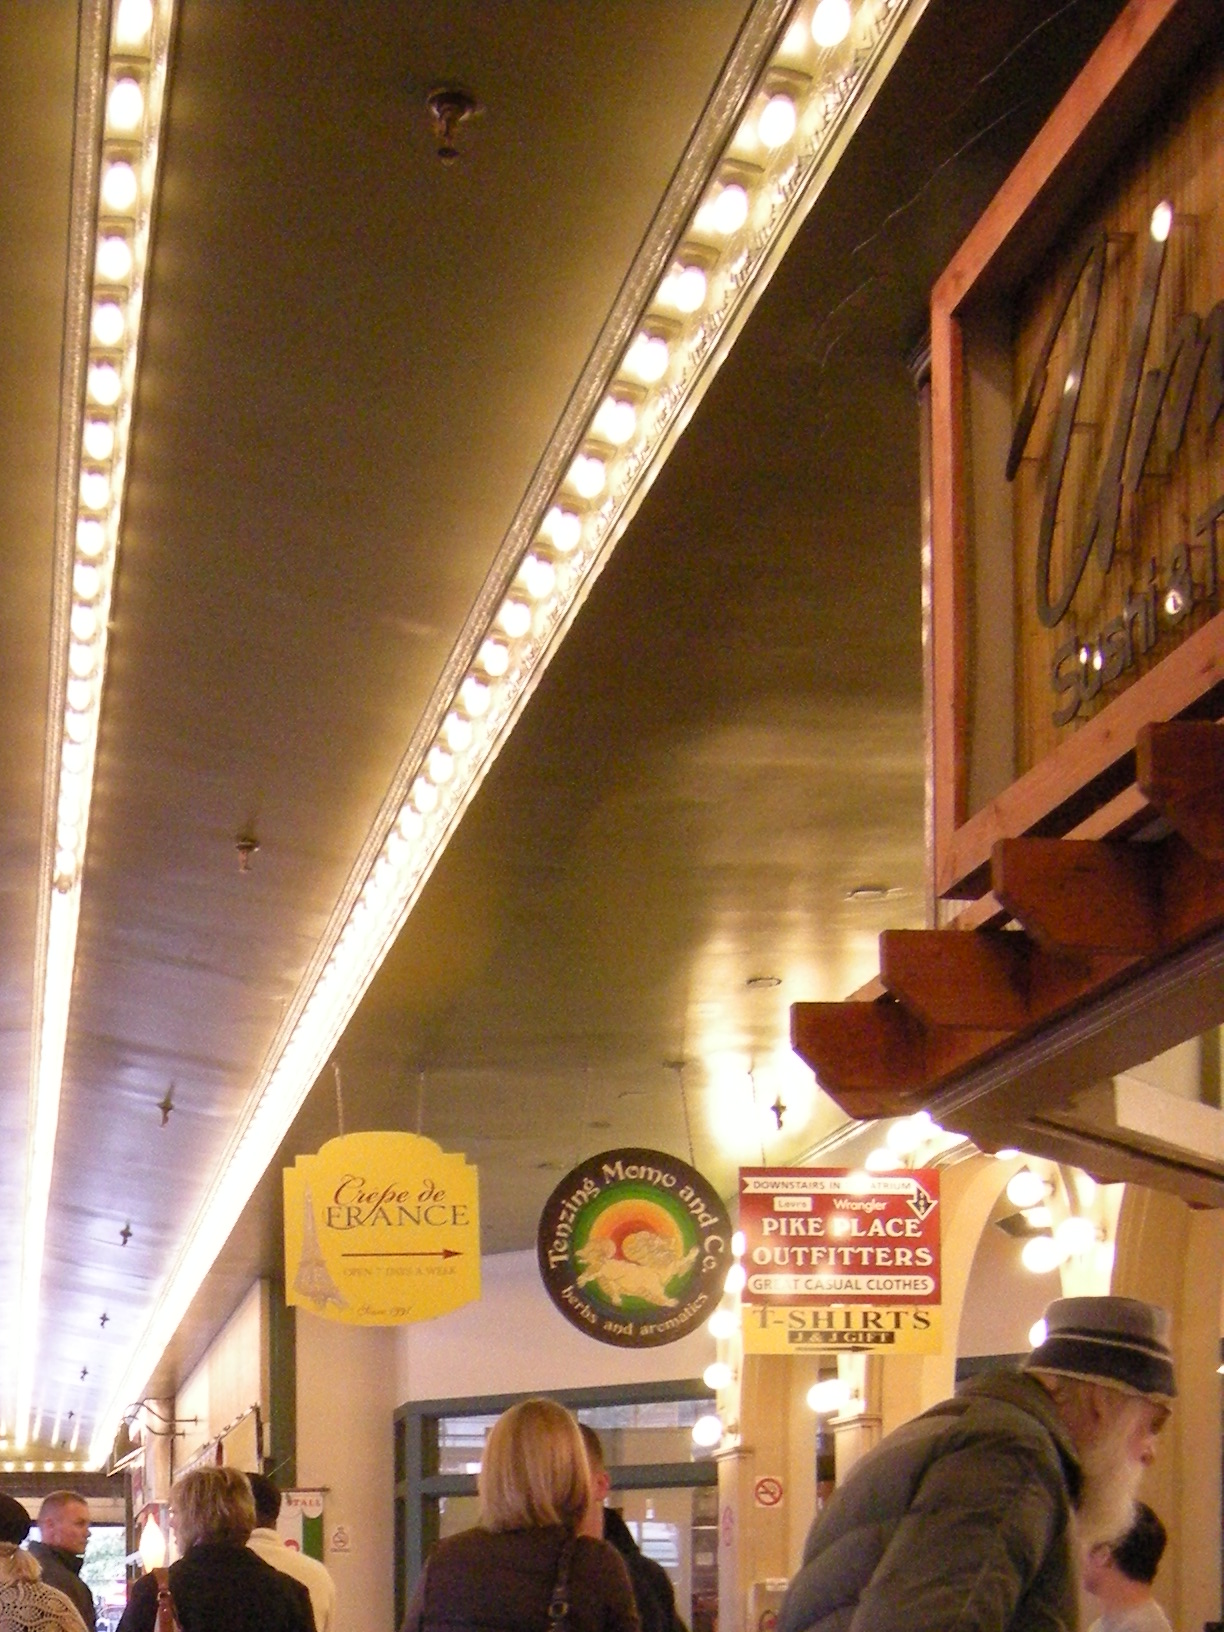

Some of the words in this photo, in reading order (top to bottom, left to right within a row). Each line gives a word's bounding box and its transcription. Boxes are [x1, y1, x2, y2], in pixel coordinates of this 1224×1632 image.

[1051, 556, 1156, 728] Sushi
[1165, 544, 1194, 627] &
[417, 1178, 447, 1203] de
[753, 1180, 825, 1190] DOWNSTAIRS
[829, 1181, 841, 1190] IN
[547, 1177, 601, 1270] Tenzing
[602, 1160, 677, 1188] Momo
[678, 1184, 720, 1230] and
[833, 1198, 889, 1214] Wrangler
[325, 1204, 471, 1230] FRANCE
[761, 1217, 826, 1237] PIKE
[832, 1217, 923, 1238] PLACE
[752, 1246, 934, 1267] OUTFITTERS
[804, 1279, 862, 1291] CASUAL
[866, 1279, 929, 1291] CLOTHES
[561, 1284, 600, 1325] herbs
[602, 1319, 635, 1336] and
[639, 1292, 709, 1337] aromatics
[752, 1309, 932, 1331] T-SHIRTS
[809, 1332, 823, 1342] &
[843, 1332, 890, 1342] GIFT
